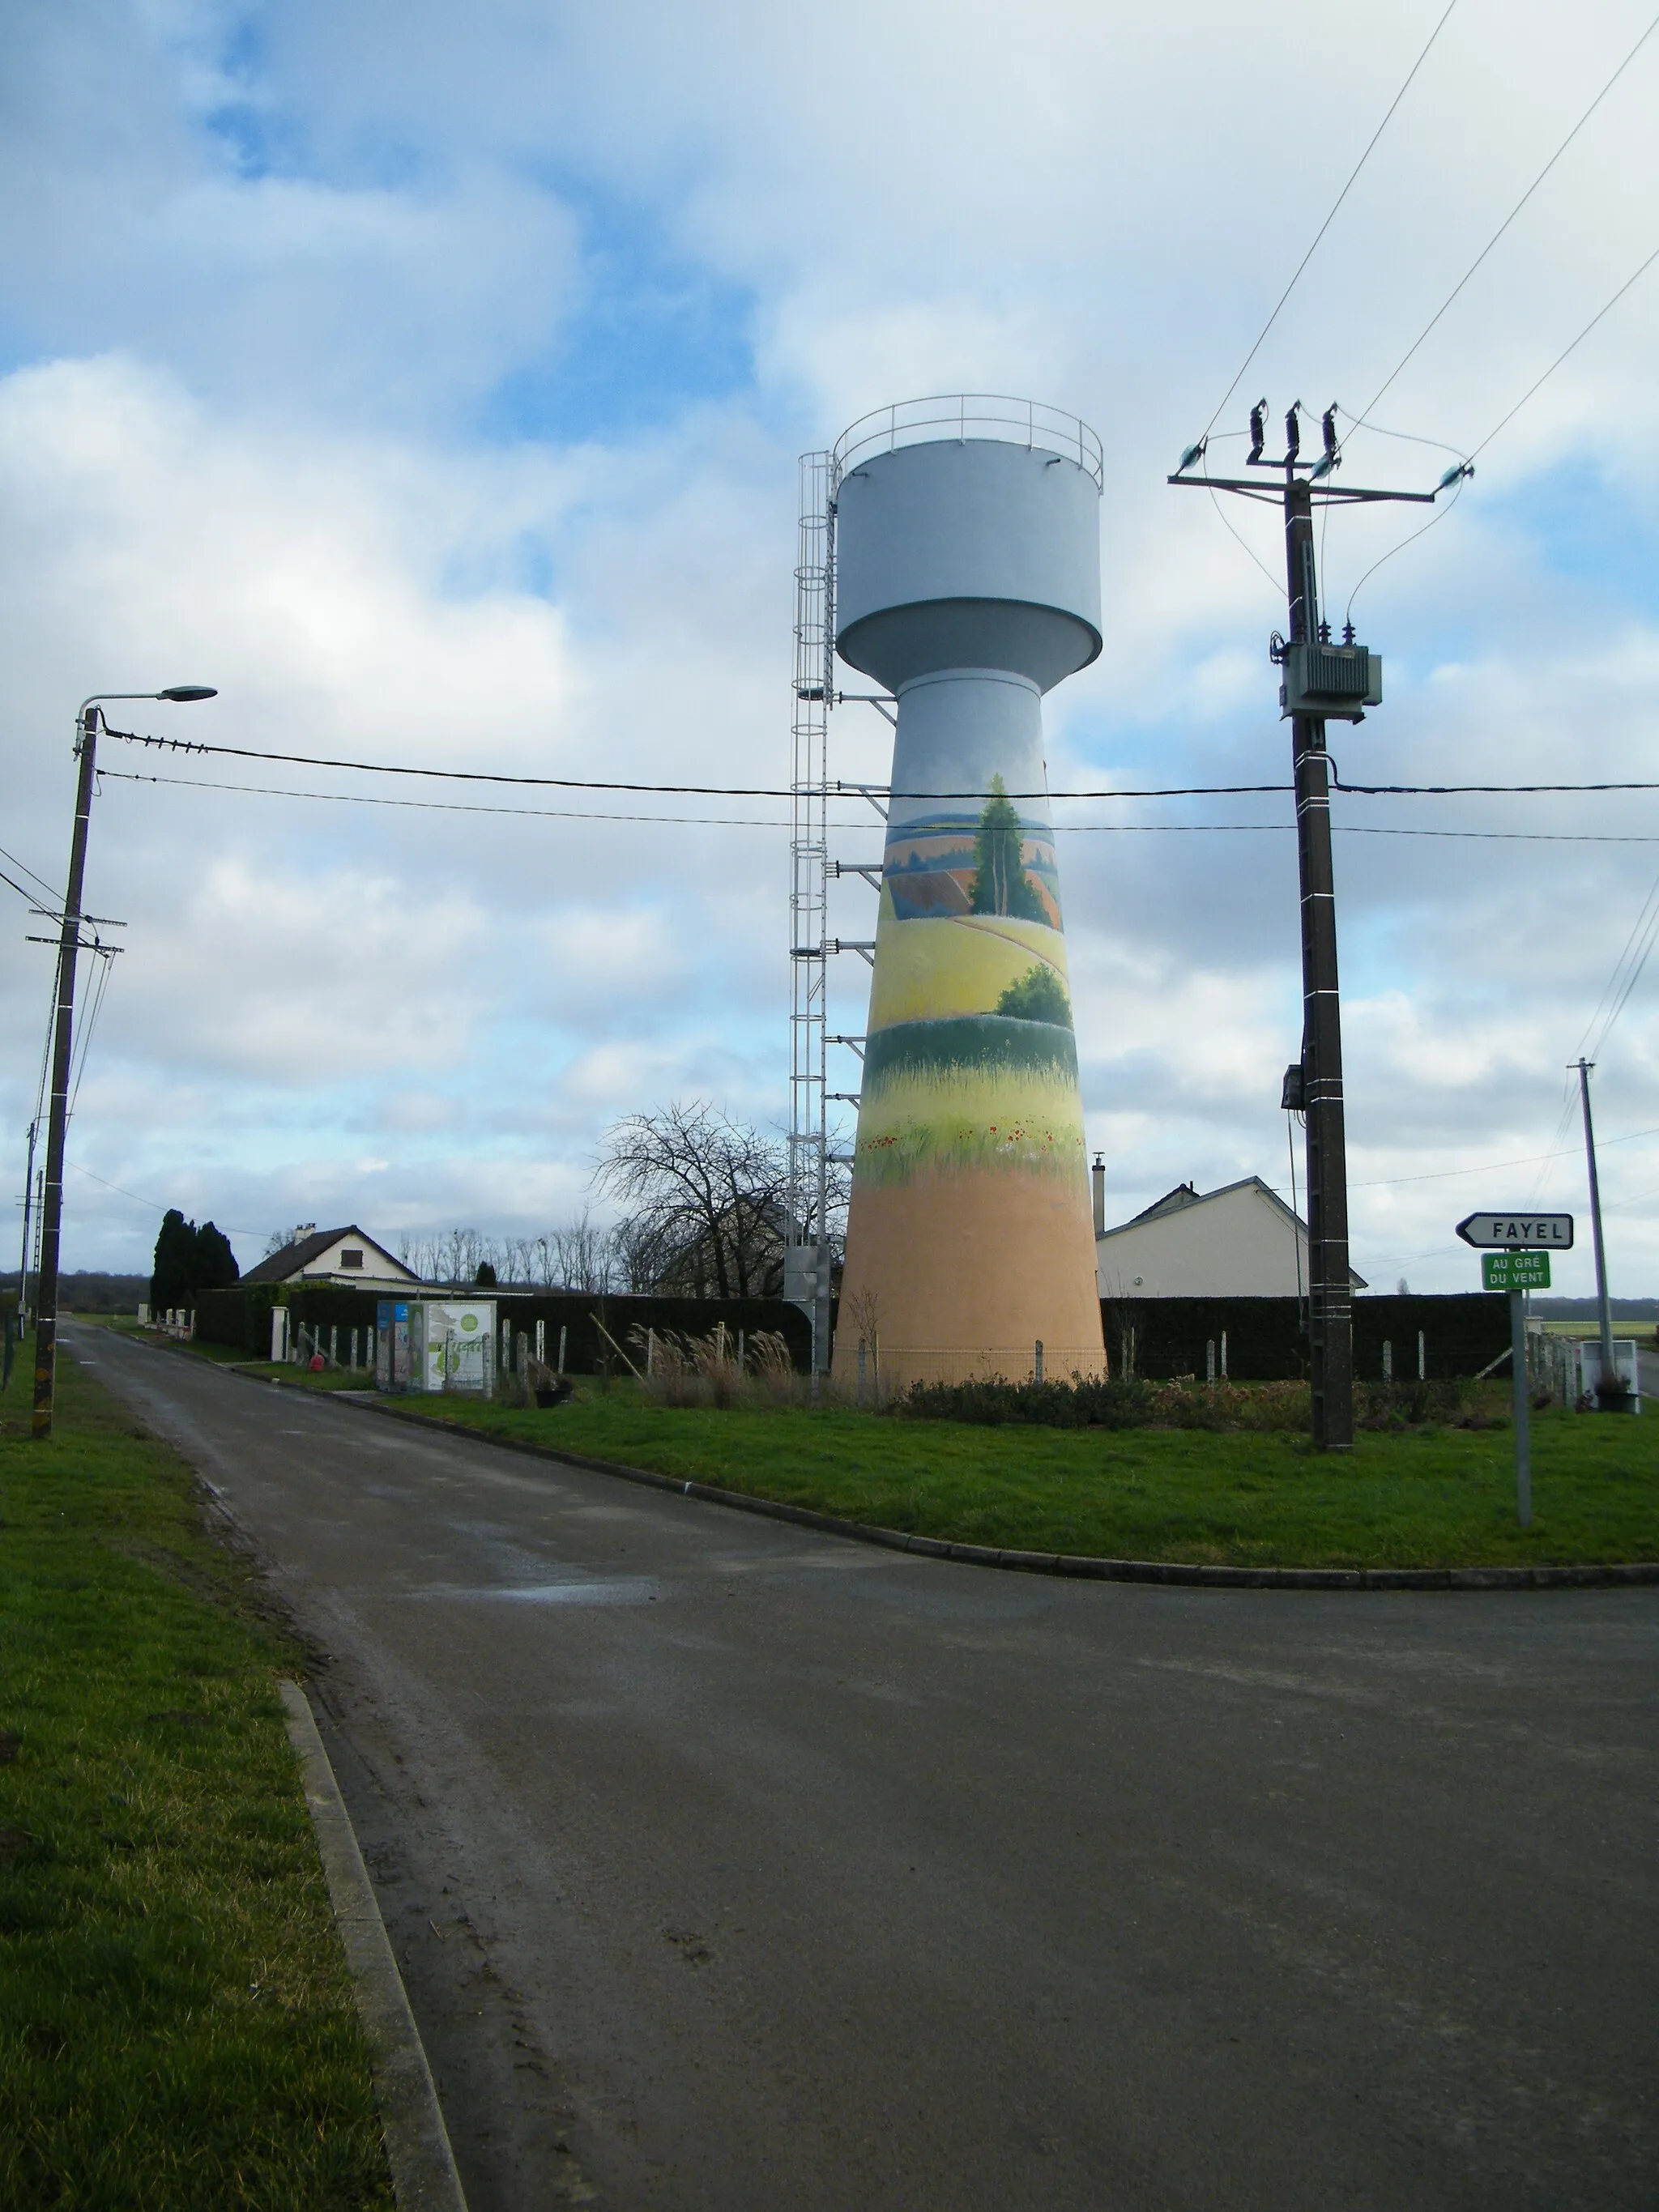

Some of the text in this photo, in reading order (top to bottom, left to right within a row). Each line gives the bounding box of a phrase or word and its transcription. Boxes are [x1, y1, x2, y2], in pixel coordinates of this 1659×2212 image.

[1493, 1222, 1563, 1239] FAYEL
[1492, 1255, 1541, 1269] AU GRÉ
[1490, 1272, 1544, 1284] DU VENT
